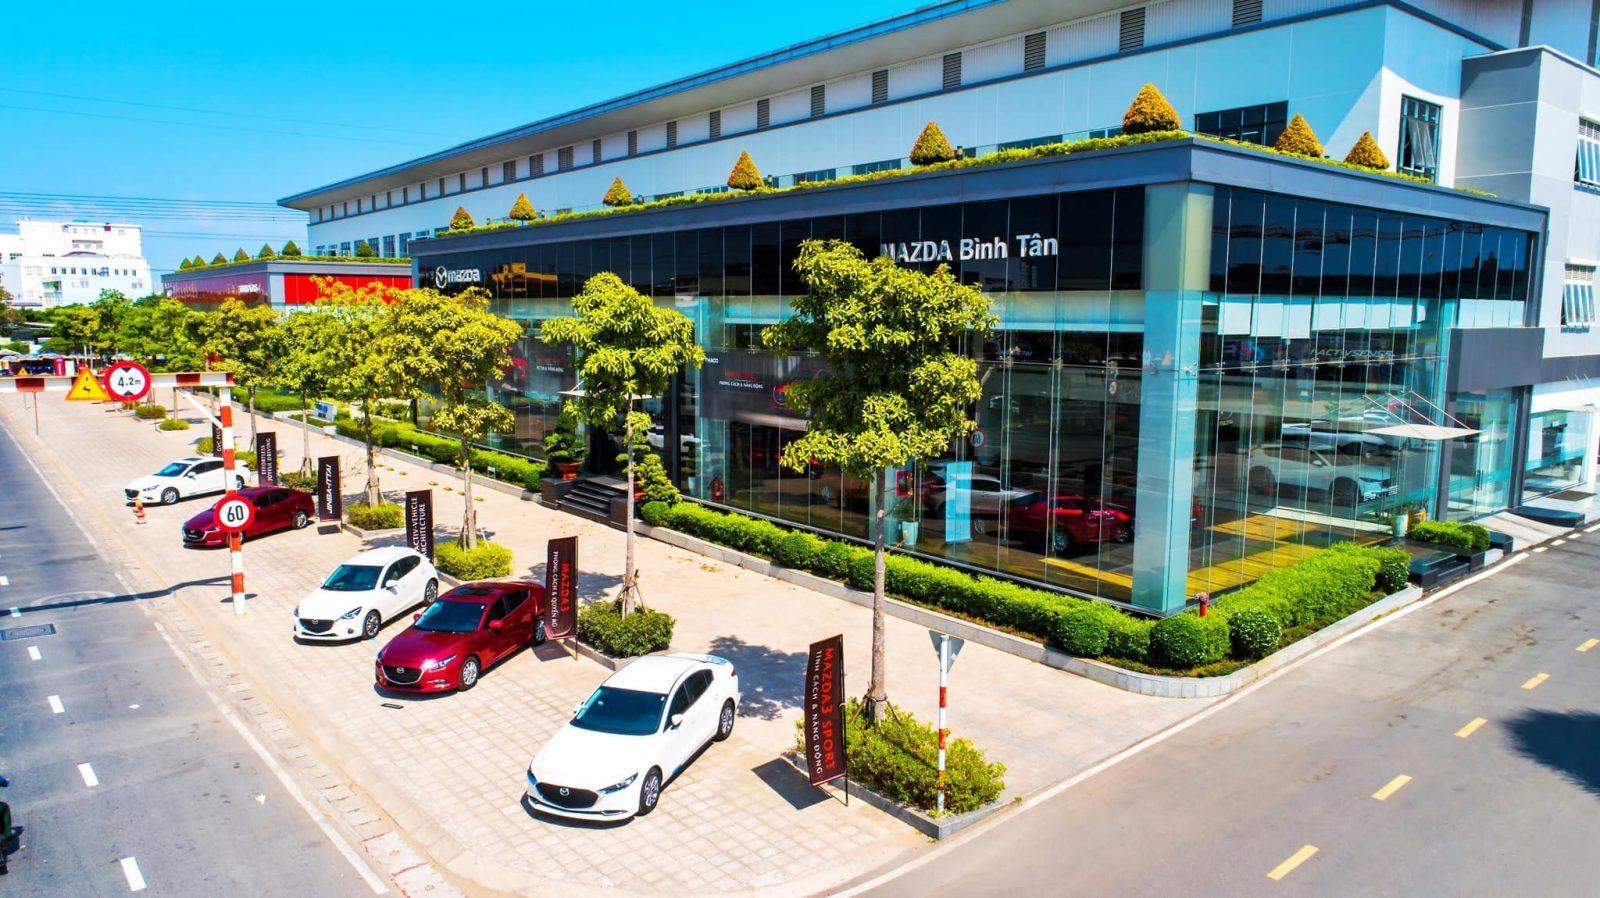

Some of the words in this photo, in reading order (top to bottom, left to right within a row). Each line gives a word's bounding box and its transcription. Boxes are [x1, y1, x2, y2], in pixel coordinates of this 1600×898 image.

[880, 240, 953, 262] MAZDA
[959, 237, 1008, 260] Bình
[1016, 232, 1058, 257] Tân
[118, 376, 141, 388] 4.2m
[228, 505, 244, 522] 60
[411, 496, 420, 552] ACTIV-VEHICLE
[821, 647, 834, 714] MAZDA3
[821, 720, 836, 769] SPORT
